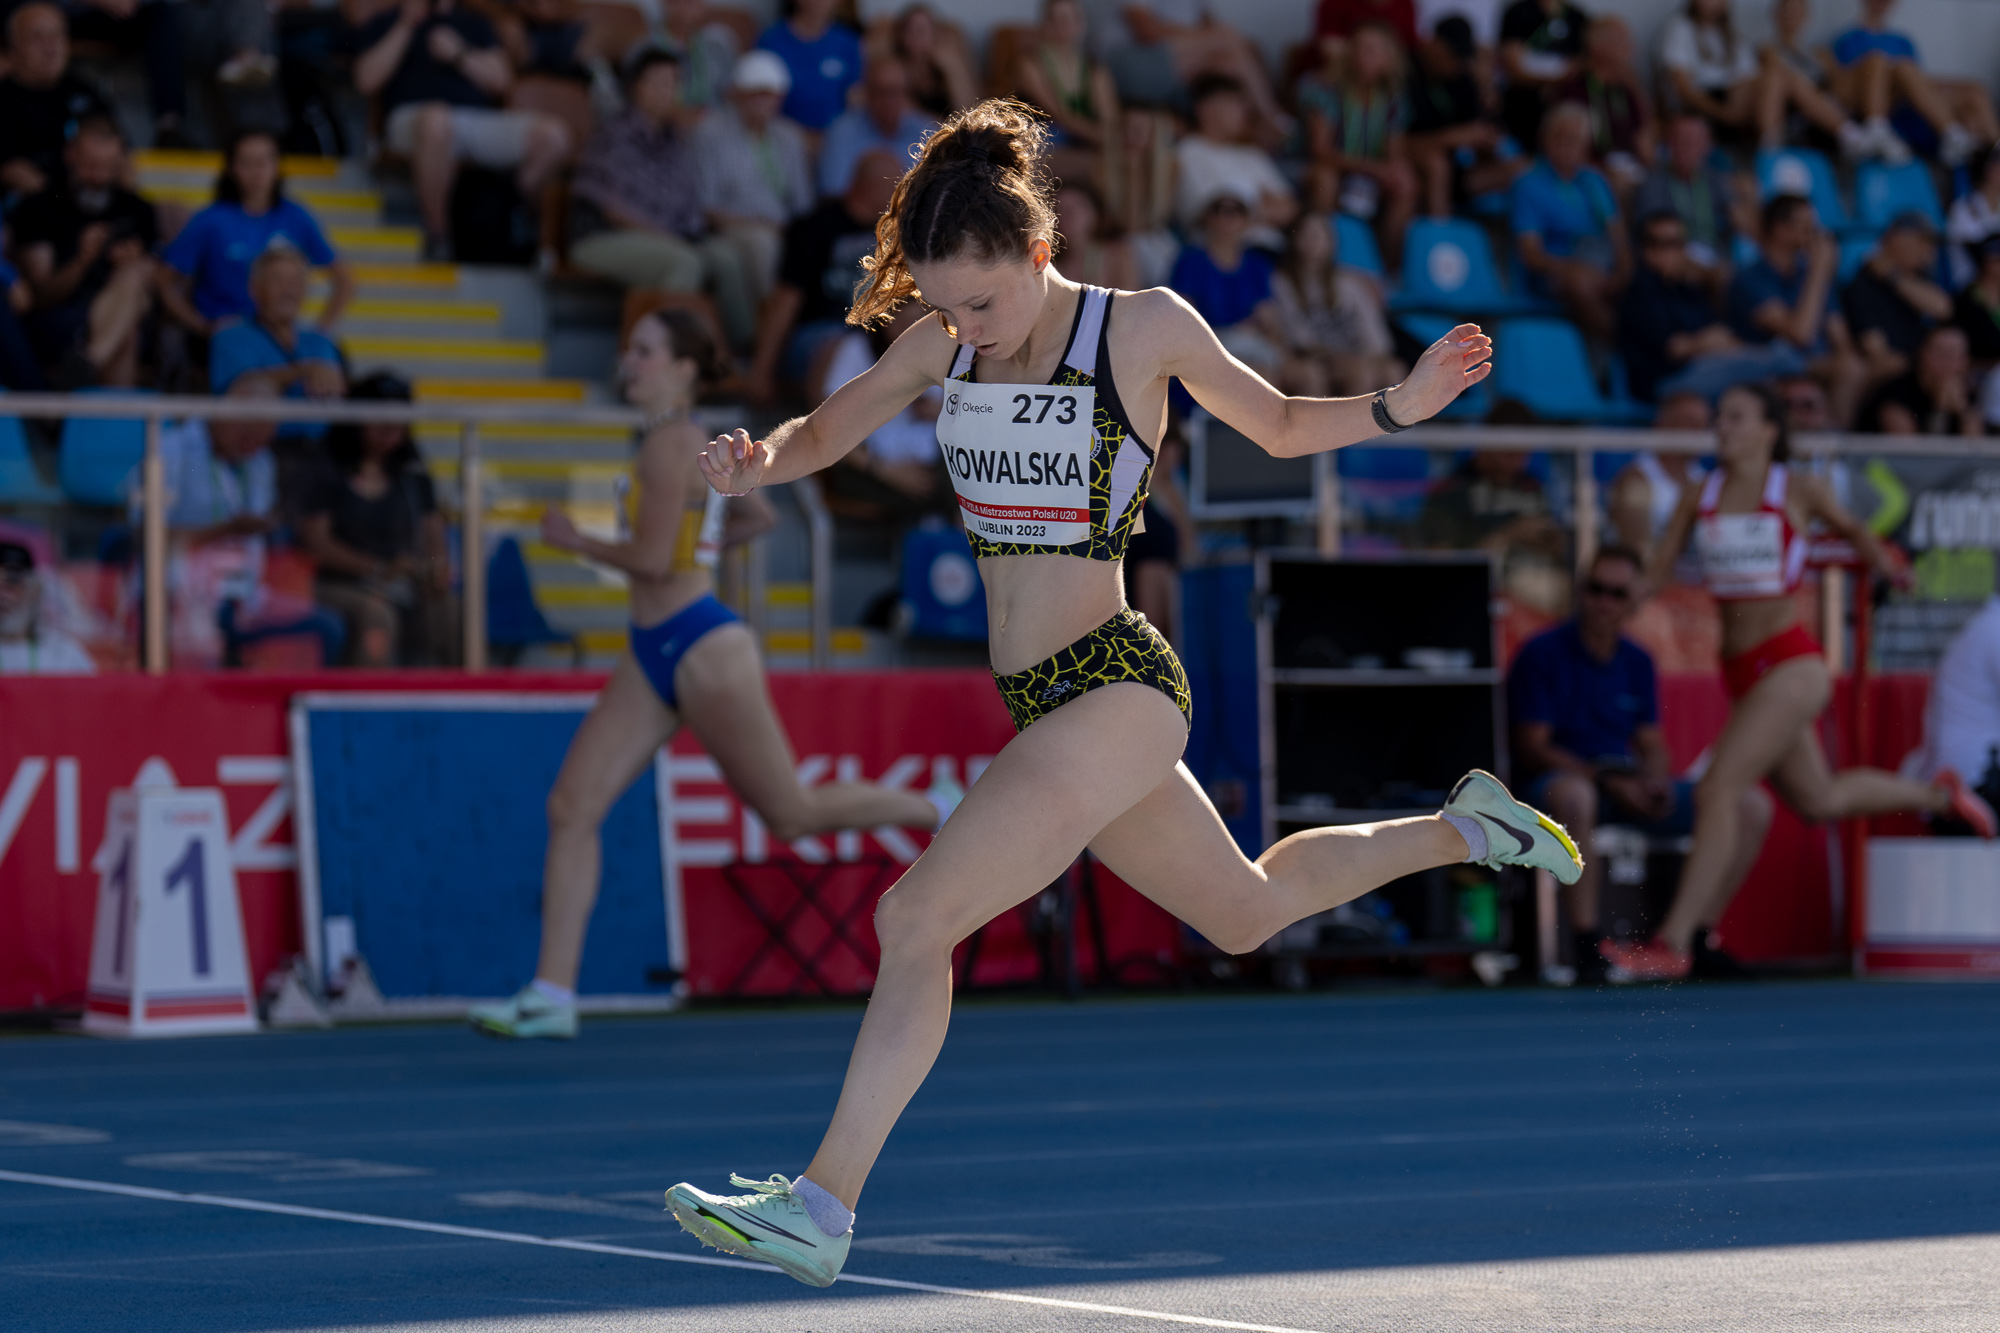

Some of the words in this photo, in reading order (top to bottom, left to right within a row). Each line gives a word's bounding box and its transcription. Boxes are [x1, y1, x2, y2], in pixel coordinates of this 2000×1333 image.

[962, 402, 993, 415] Okęcie
[1012, 393, 1077, 424] 273
[944, 443, 1084, 487] KOWALSKA
[980, 506, 1030, 518] Mistrzostwa
[1032, 509, 1058, 519] Polski
[1060, 511, 1077, 520] U20
[978, 520, 1013, 536] LUBLIN
[1016, 525, 1046, 537] 2023
[165, 837, 210, 978] 1
